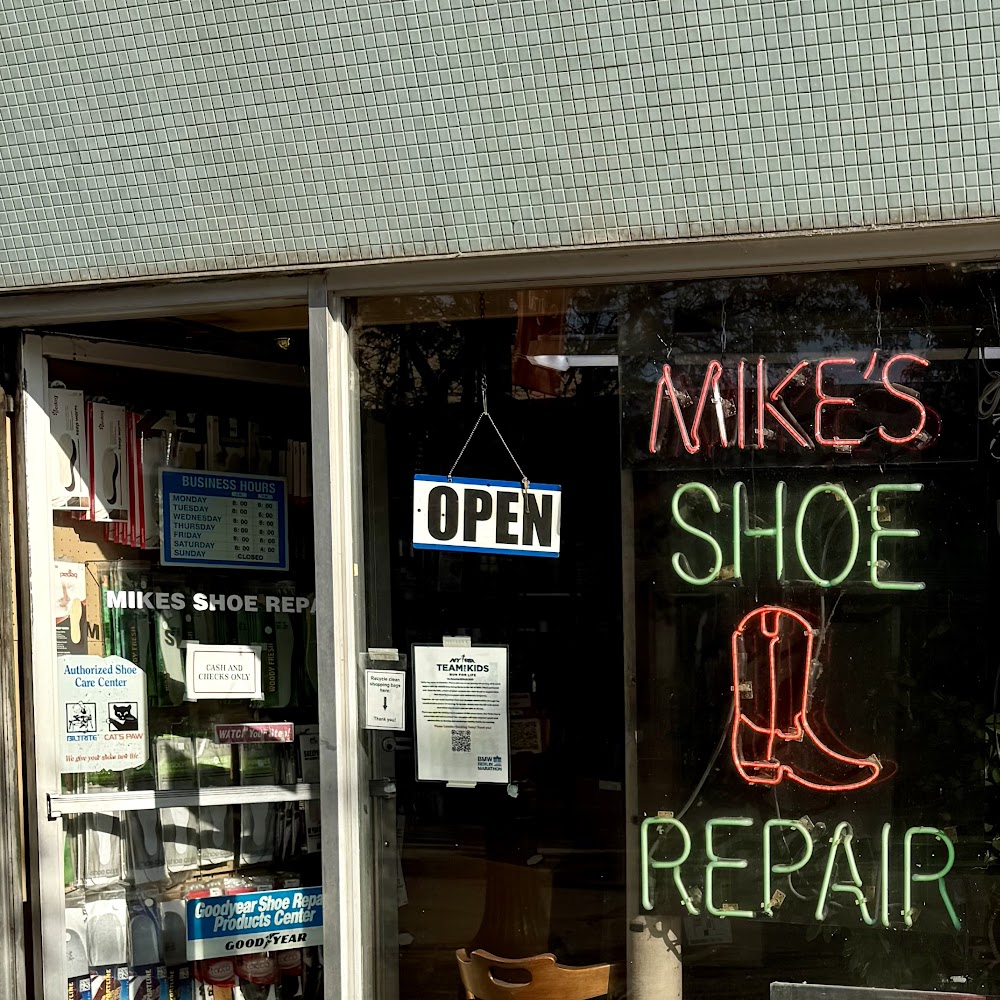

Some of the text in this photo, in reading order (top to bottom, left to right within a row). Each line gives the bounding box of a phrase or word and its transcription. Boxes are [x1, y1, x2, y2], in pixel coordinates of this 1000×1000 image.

[650, 348, 930, 454] MIKE'S
[182, 475, 276, 494] BUSINESS HOURS
[173, 494, 207, 504] MONDAY
[173, 504, 209, 513] TUESDAY
[173, 513, 222, 523] WEDNESDAY
[427, 485, 553, 547] OPEN
[174, 522, 216, 531] THURSDAY
[173, 531, 202, 539] FRIDAY
[671, 480, 926, 590] SHOE
[174, 540, 215, 550] SATURDAY
[174, 549, 264, 561] SUNDAY CLOSED
[106, 590, 186, 610] MIKES
[193, 592, 258, 612] SHOE
[64, 664, 138, 676] Authorized Shoe
[206, 664, 227, 672] CASH
[198, 672, 251, 681] CHECKS ONLY
[75, 677, 127, 687] Care Center
[104, 733, 125, 741] CAT'S
[75, 754, 88, 763] give
[640, 817, 962, 930] REPAIR
[195, 899, 258, 919] Goodyear
[257, 895, 290, 912] Shoe
[213, 909, 317, 932] Products Center
